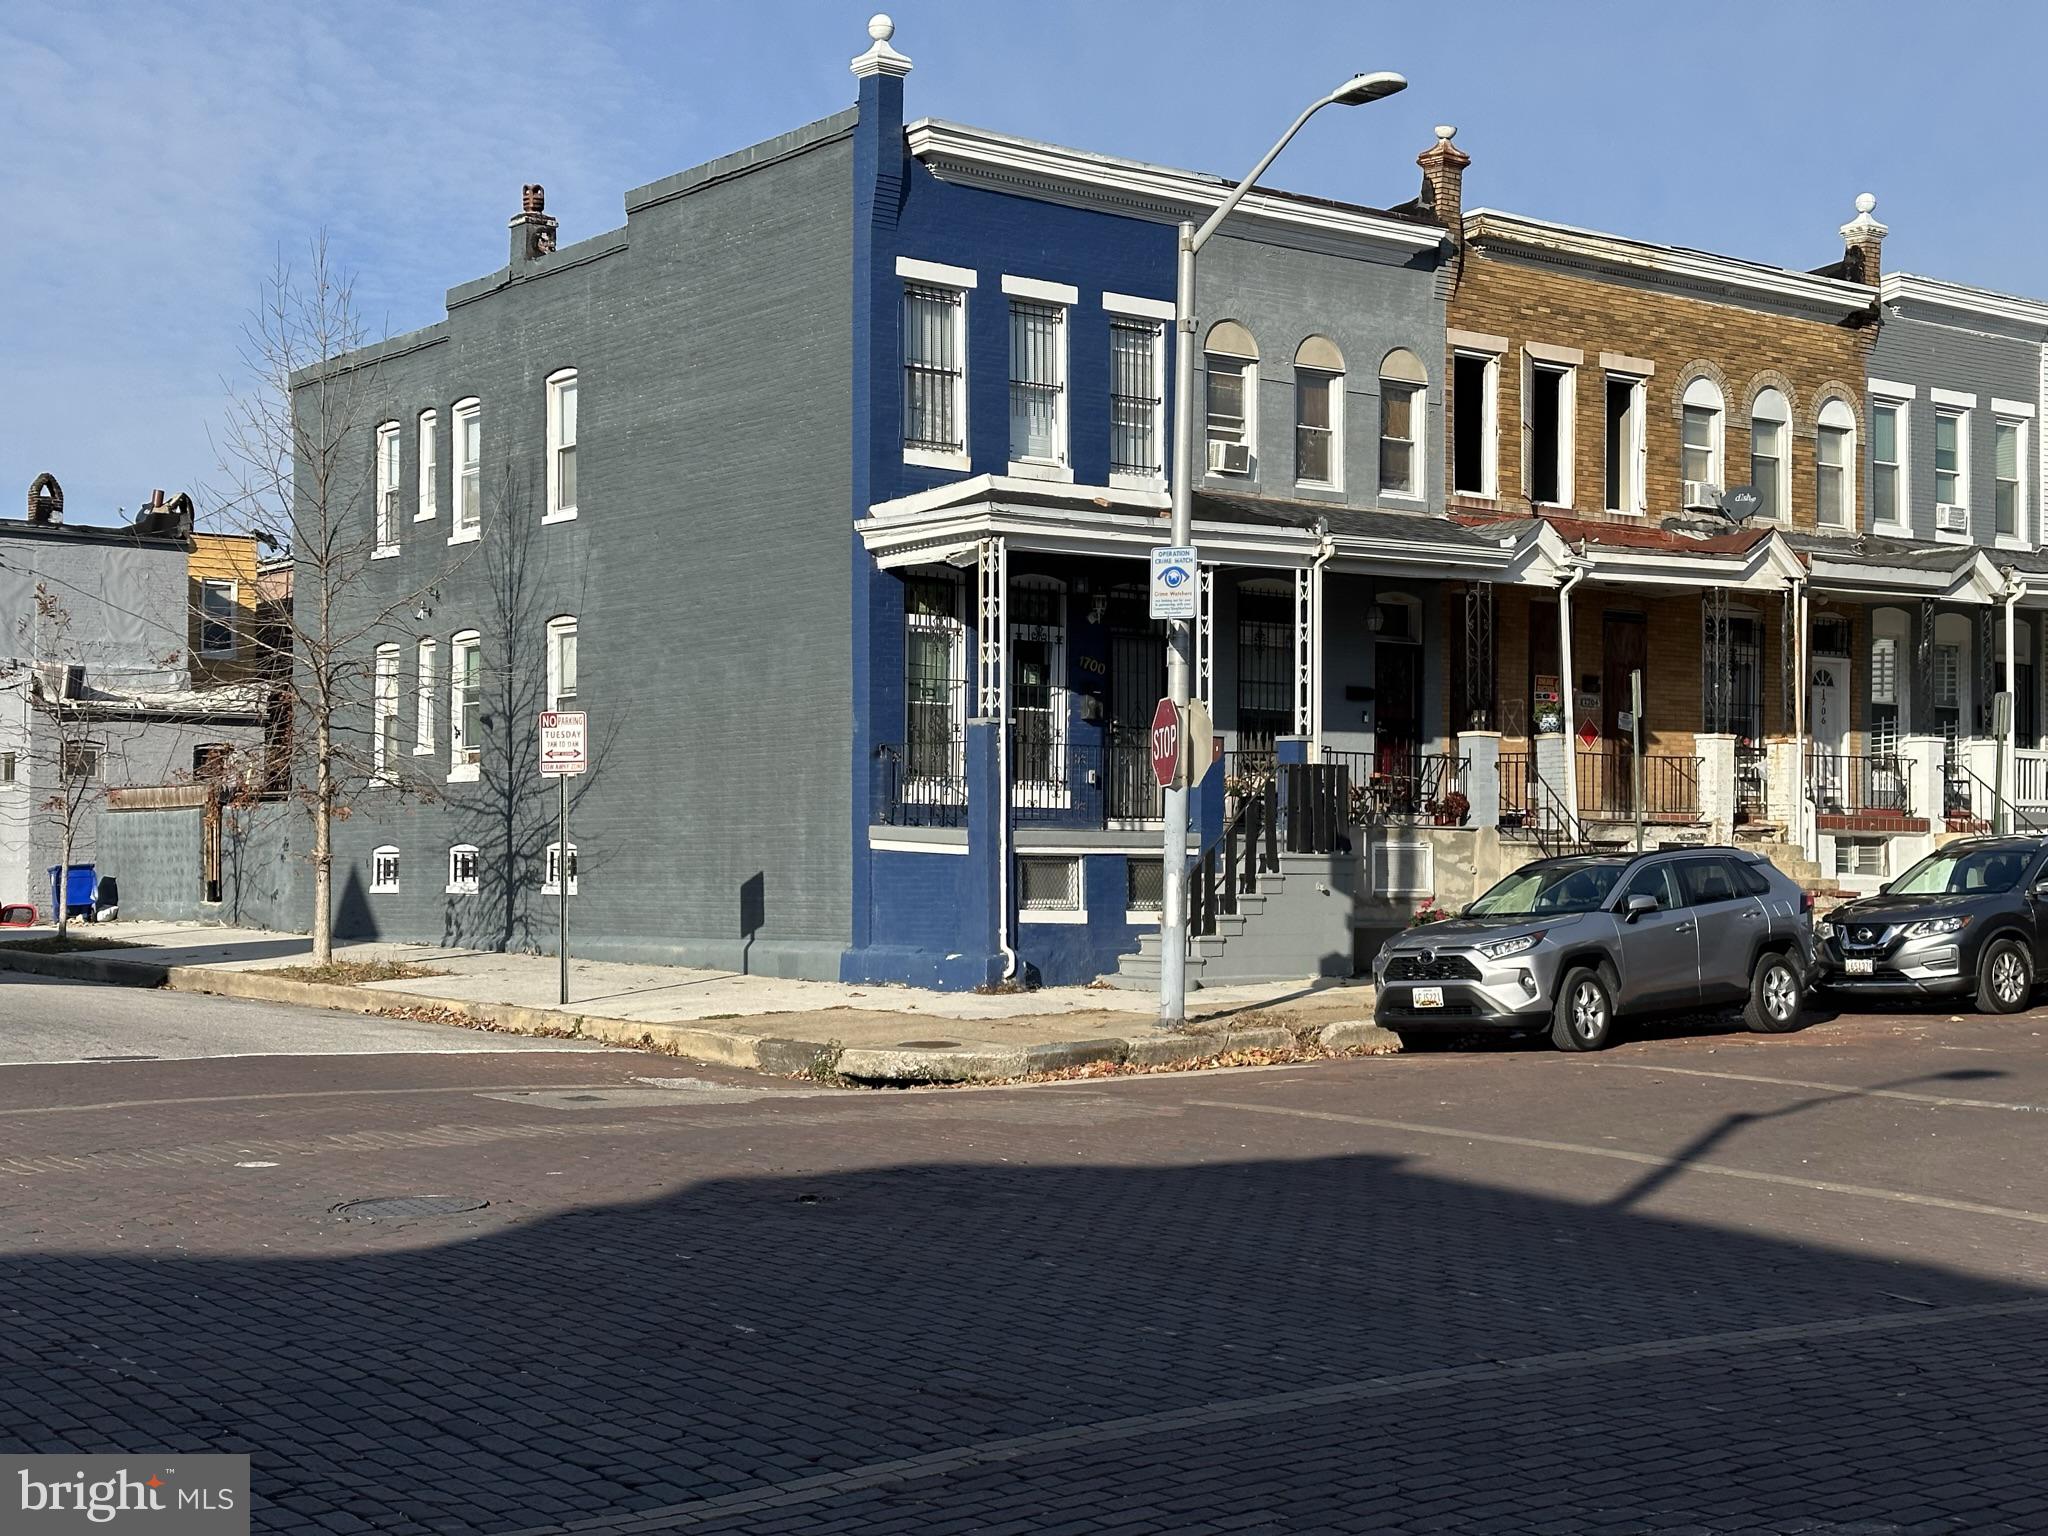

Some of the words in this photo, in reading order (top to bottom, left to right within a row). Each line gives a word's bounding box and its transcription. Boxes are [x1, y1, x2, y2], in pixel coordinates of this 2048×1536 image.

[1079, 655, 1106, 675] 1700
[542, 715, 557, 727] NO
[557, 716, 583, 726] PARKING
[545, 731, 581, 739] TUESDAY
[1153, 725, 1177, 760] STOP
